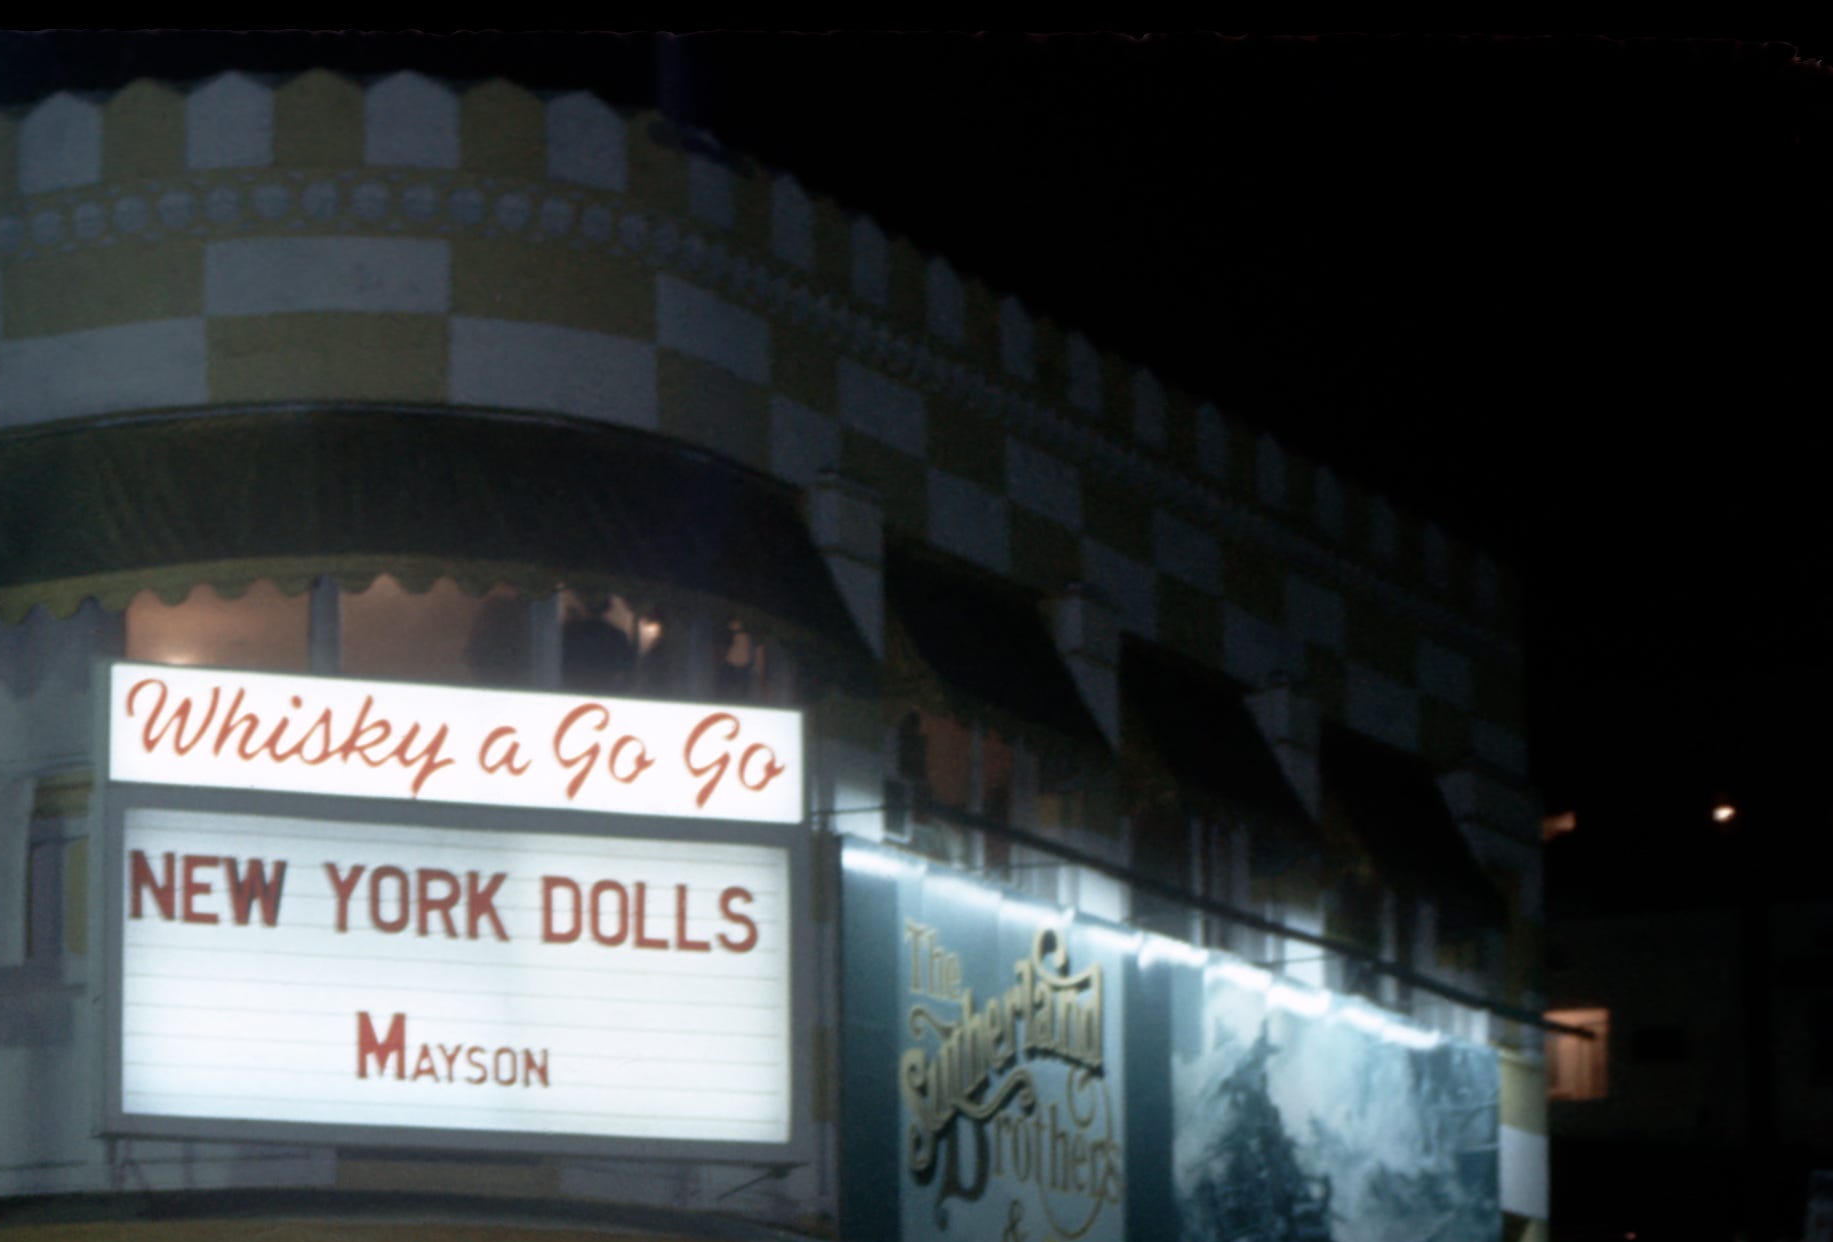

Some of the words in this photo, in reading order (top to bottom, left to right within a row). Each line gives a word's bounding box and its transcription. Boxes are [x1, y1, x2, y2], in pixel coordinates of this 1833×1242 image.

[125, 678, 454, 799] Whisky
[478, 725, 531, 775] a
[553, 703, 654, 799] Go
[683, 712, 784, 808] Go
[129, 850, 287, 927] NEW
[326, 862, 510, 941] YORK
[541, 875, 758, 953] DOLLS
[904, 917, 961, 1000] The
[899, 928, 1104, 1134] Sutherland
[909, 1070, 1121, 1240] Brothers
